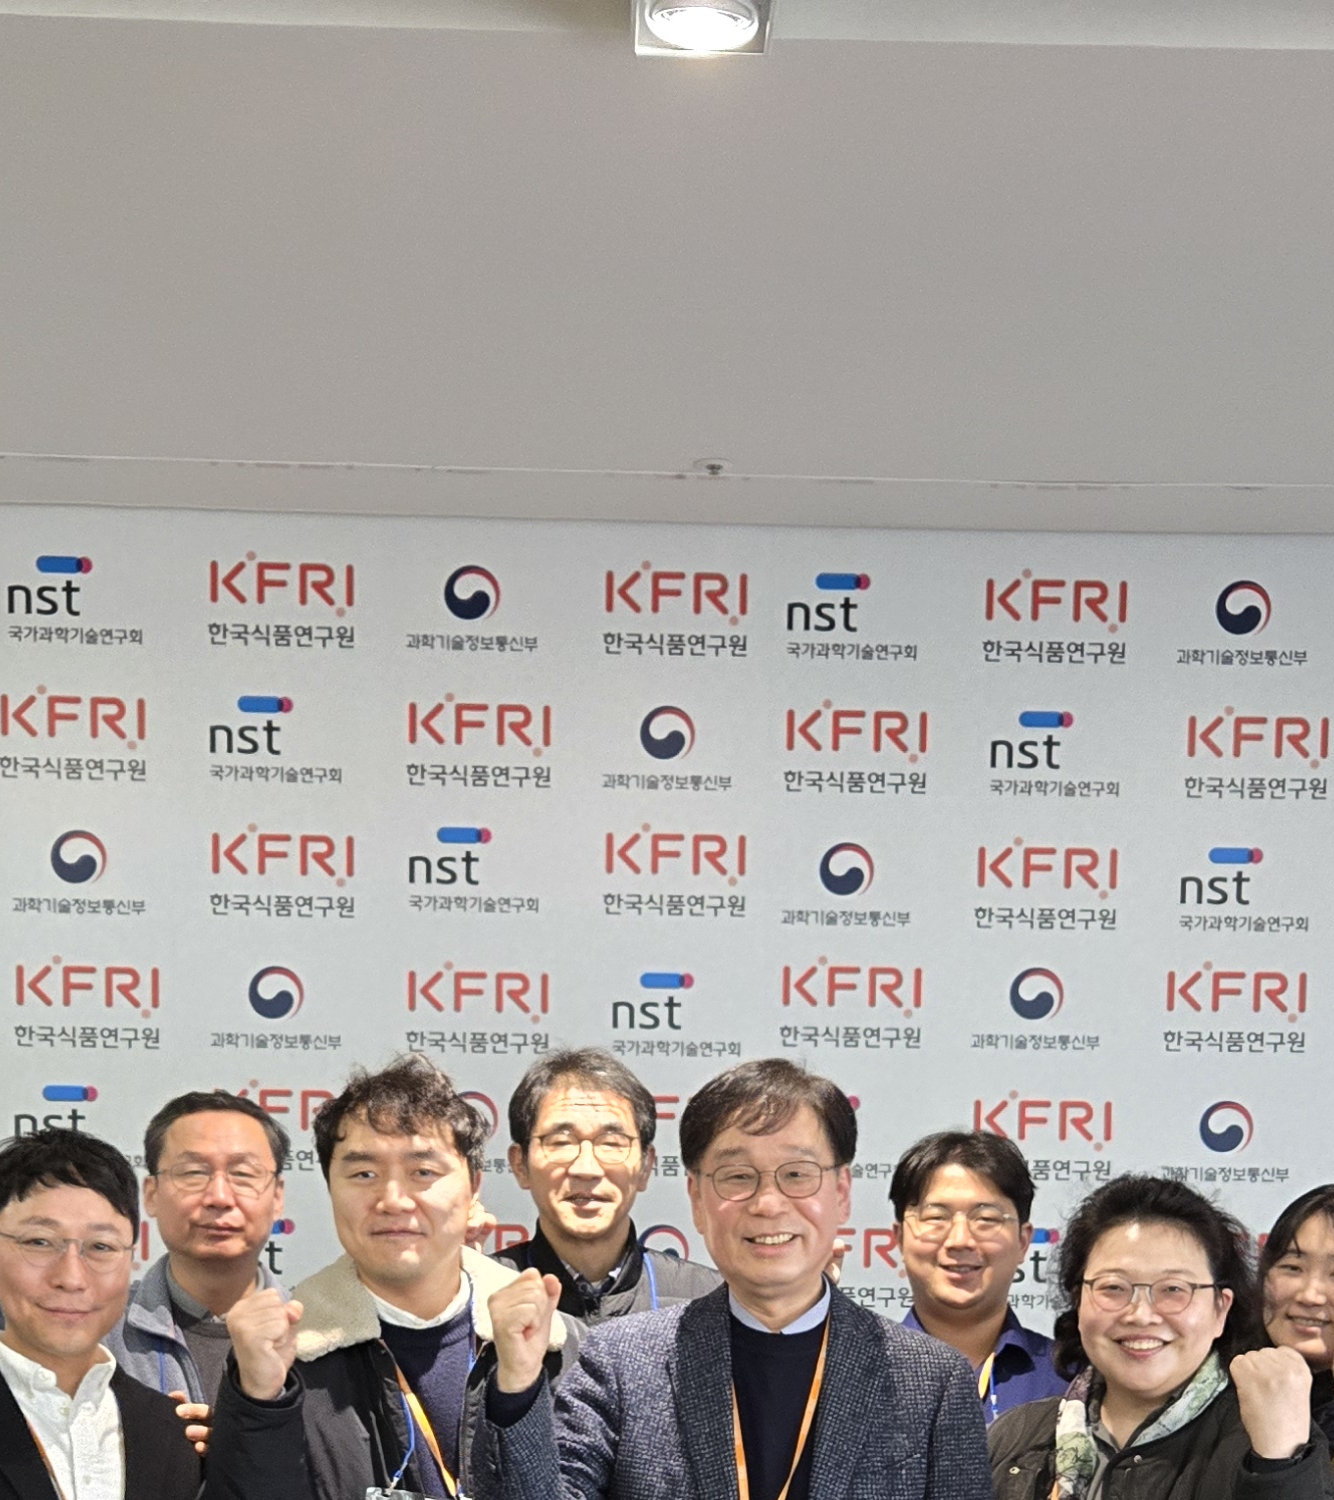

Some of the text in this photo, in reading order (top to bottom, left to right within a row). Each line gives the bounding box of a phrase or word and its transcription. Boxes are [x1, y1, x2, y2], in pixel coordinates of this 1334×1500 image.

[210, 563, 353, 606] KFRI
[606, 572, 747, 614] KFRI
[8, 580, 80, 616] nst
[987, 580, 1127, 622] KFRI
[787, 597, 857, 632] nst
[9, 626, 143, 645] 국가과학기술연구회
[208, 623, 354, 648] 한국식품연구원
[407, 634, 537, 652] 과학기술정보통신부
[603, 632, 747, 657] 한국식품연구원
[788, 643, 917, 660] 국가과학기술연구회
[983, 640, 1125, 664] 한국식품연구원
[1177, 649, 1307, 666] 과학기술정보통신부
[1, 696, 145, 738] KFRI
[408, 704, 550, 745] KFRI
[210, 720, 280, 755] nst
[787, 711, 928, 752] KFRI
[1188, 717, 1328, 757] KFRI
[991, 735, 1060, 769] nst
[0, 756, 146, 782] 한국식품연구원
[211, 765, 342, 783] 국가과학기술연구회
[407, 764, 550, 788] 한국식품연구원
[603, 774, 731, 791] 과학기술정보통신부
[784, 770, 926, 794] 한국식품연구원
[991, 780, 1119, 797] 국가과학기술연구회
[1185, 777, 1327, 800] 한국식품연구원
[212, 834, 353, 875] KFRI
[606, 834, 745, 874] KFRI
[409, 851, 479, 885] nst
[979, 847, 1117, 887] KFRI
[1180, 871, 1250, 905] nst
[210, 894, 354, 918] 한국식품연구원
[410, 895, 539, 913] 국가과학기술연구회
[604, 893, 745, 917] 한국식품연구원
[782, 910, 910, 926] 과학기술정보통신부
[975, 907, 1116, 930] 한국식품연구원
[1180, 916, 1309, 932] 국가과학기술연구회
[17, 966, 159, 1007] KFRI
[407, 971, 548, 1012] KFRI
[783, 966, 922, 1006] KFRI
[1167, 972, 1306, 1011] KFRI
[612, 996, 681, 1030] nst
[15, 1025, 159, 1049] 한국식품연구원
[404, 1031, 550, 1055] 한국식품연구원
[612, 1037, 742, 1059] 국가과학기술연구회
[780, 1026, 921, 1049] 한국식품연구원
[972, 1034, 1099, 1050] 과학기술정보통신부
[1164, 1031, 1305, 1053] 한국식품연구원
